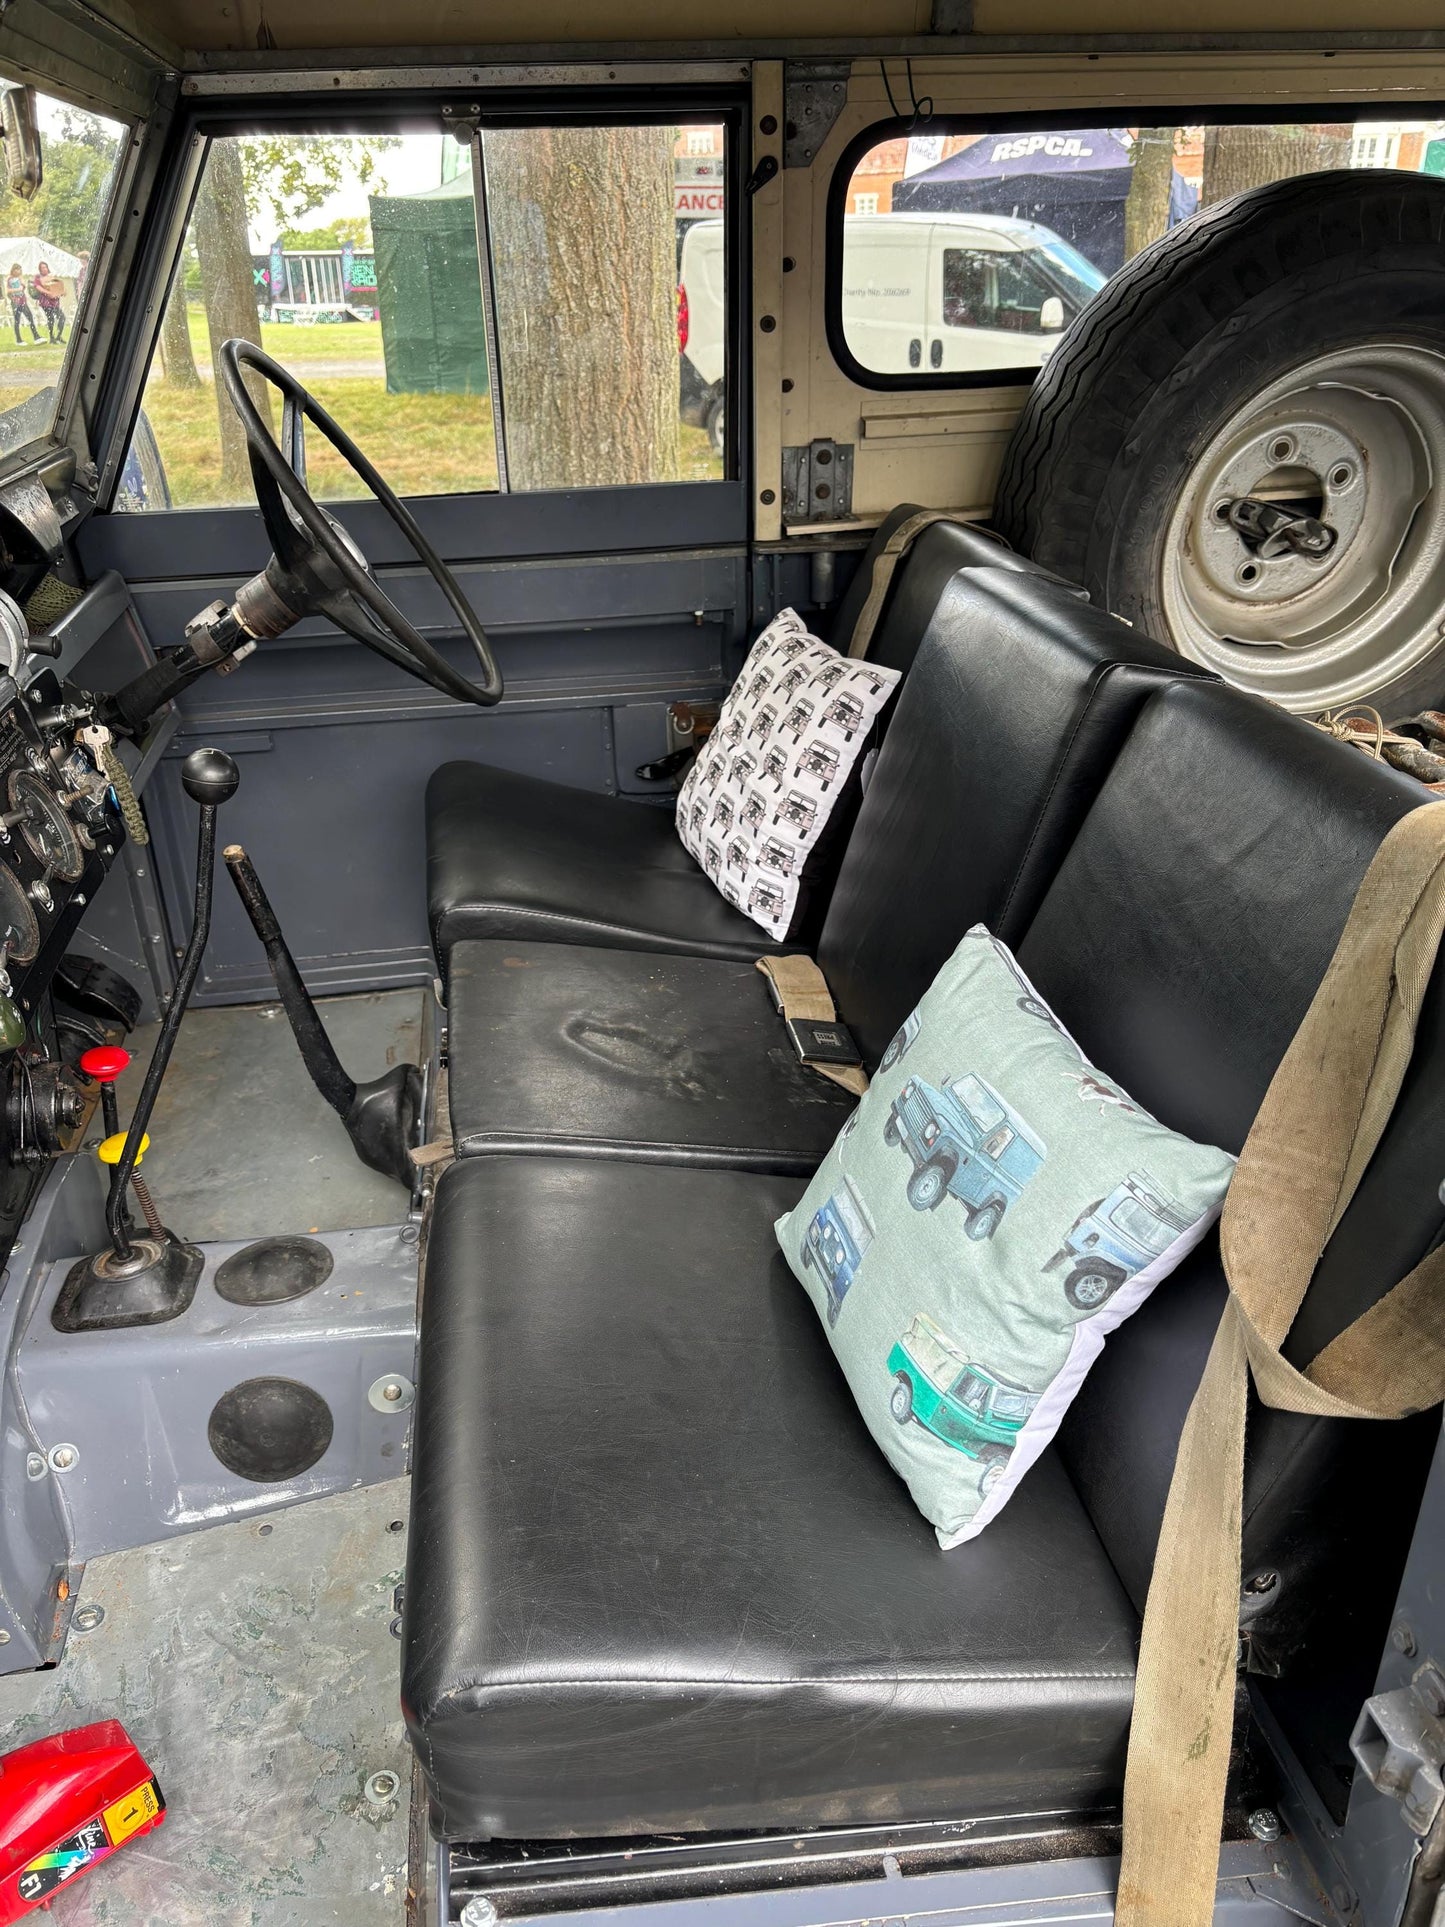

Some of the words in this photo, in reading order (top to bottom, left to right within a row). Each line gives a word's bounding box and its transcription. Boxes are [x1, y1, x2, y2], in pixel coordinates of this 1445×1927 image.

[141, 1786, 155, 1812] PRESS
[123, 1807, 139, 1822] 1
[21, 1873, 42, 1898] F1
